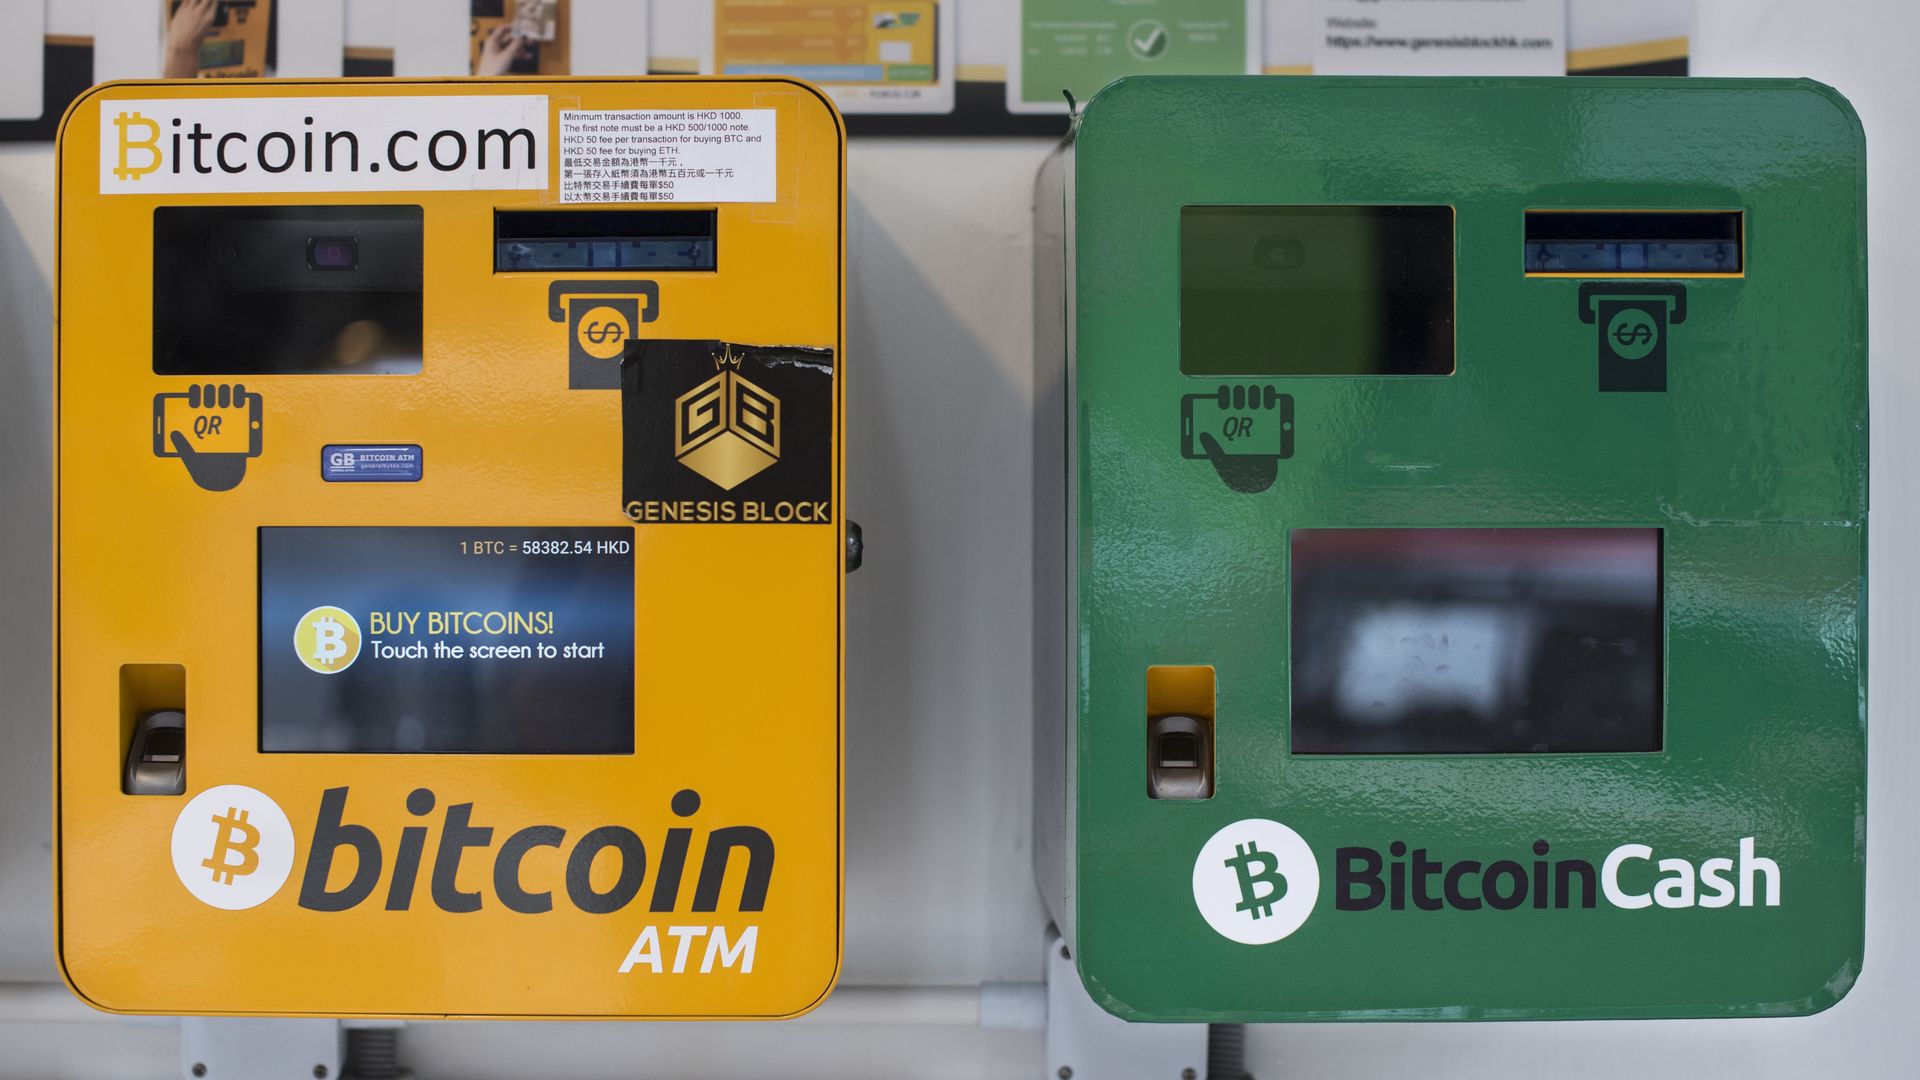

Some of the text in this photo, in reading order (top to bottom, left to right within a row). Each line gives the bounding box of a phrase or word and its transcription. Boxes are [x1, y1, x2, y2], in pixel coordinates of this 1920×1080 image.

[564, 112, 743, 121] Minimum transaction amount is HKD 1000.
[564, 124, 580, 132] The
[582, 124, 599, 132] first
[621, 124, 643, 132] must
[644, 124, 656, 132] be
[665, 124, 686, 132] HKD
[688, 124, 728, 132] 500/1000
[730, 124, 750, 132] note.
[564, 135, 762, 145] HKD 50 fee per transaction for buying BTC and
[564, 147, 680, 156] HKD 50 fee for buying ETH.
[193, 415, 222, 439] QR
[1222, 416, 1253, 442] QR
[330, 453, 355, 466] GB
[626, 501, 829, 522] GENESIS BLOCK
[460, 541, 467, 555] 1
[474, 541, 505, 555] BTC
[522, 541, 593, 555] 58382.54
[598, 541, 630, 555] HKD
[370, 611, 554, 636] BUY BITCOINS!
[371, 641, 605, 659] Touch the screen to start
[298, 785, 776, 914] bitcoin
[618, 925, 759, 975] ATM
